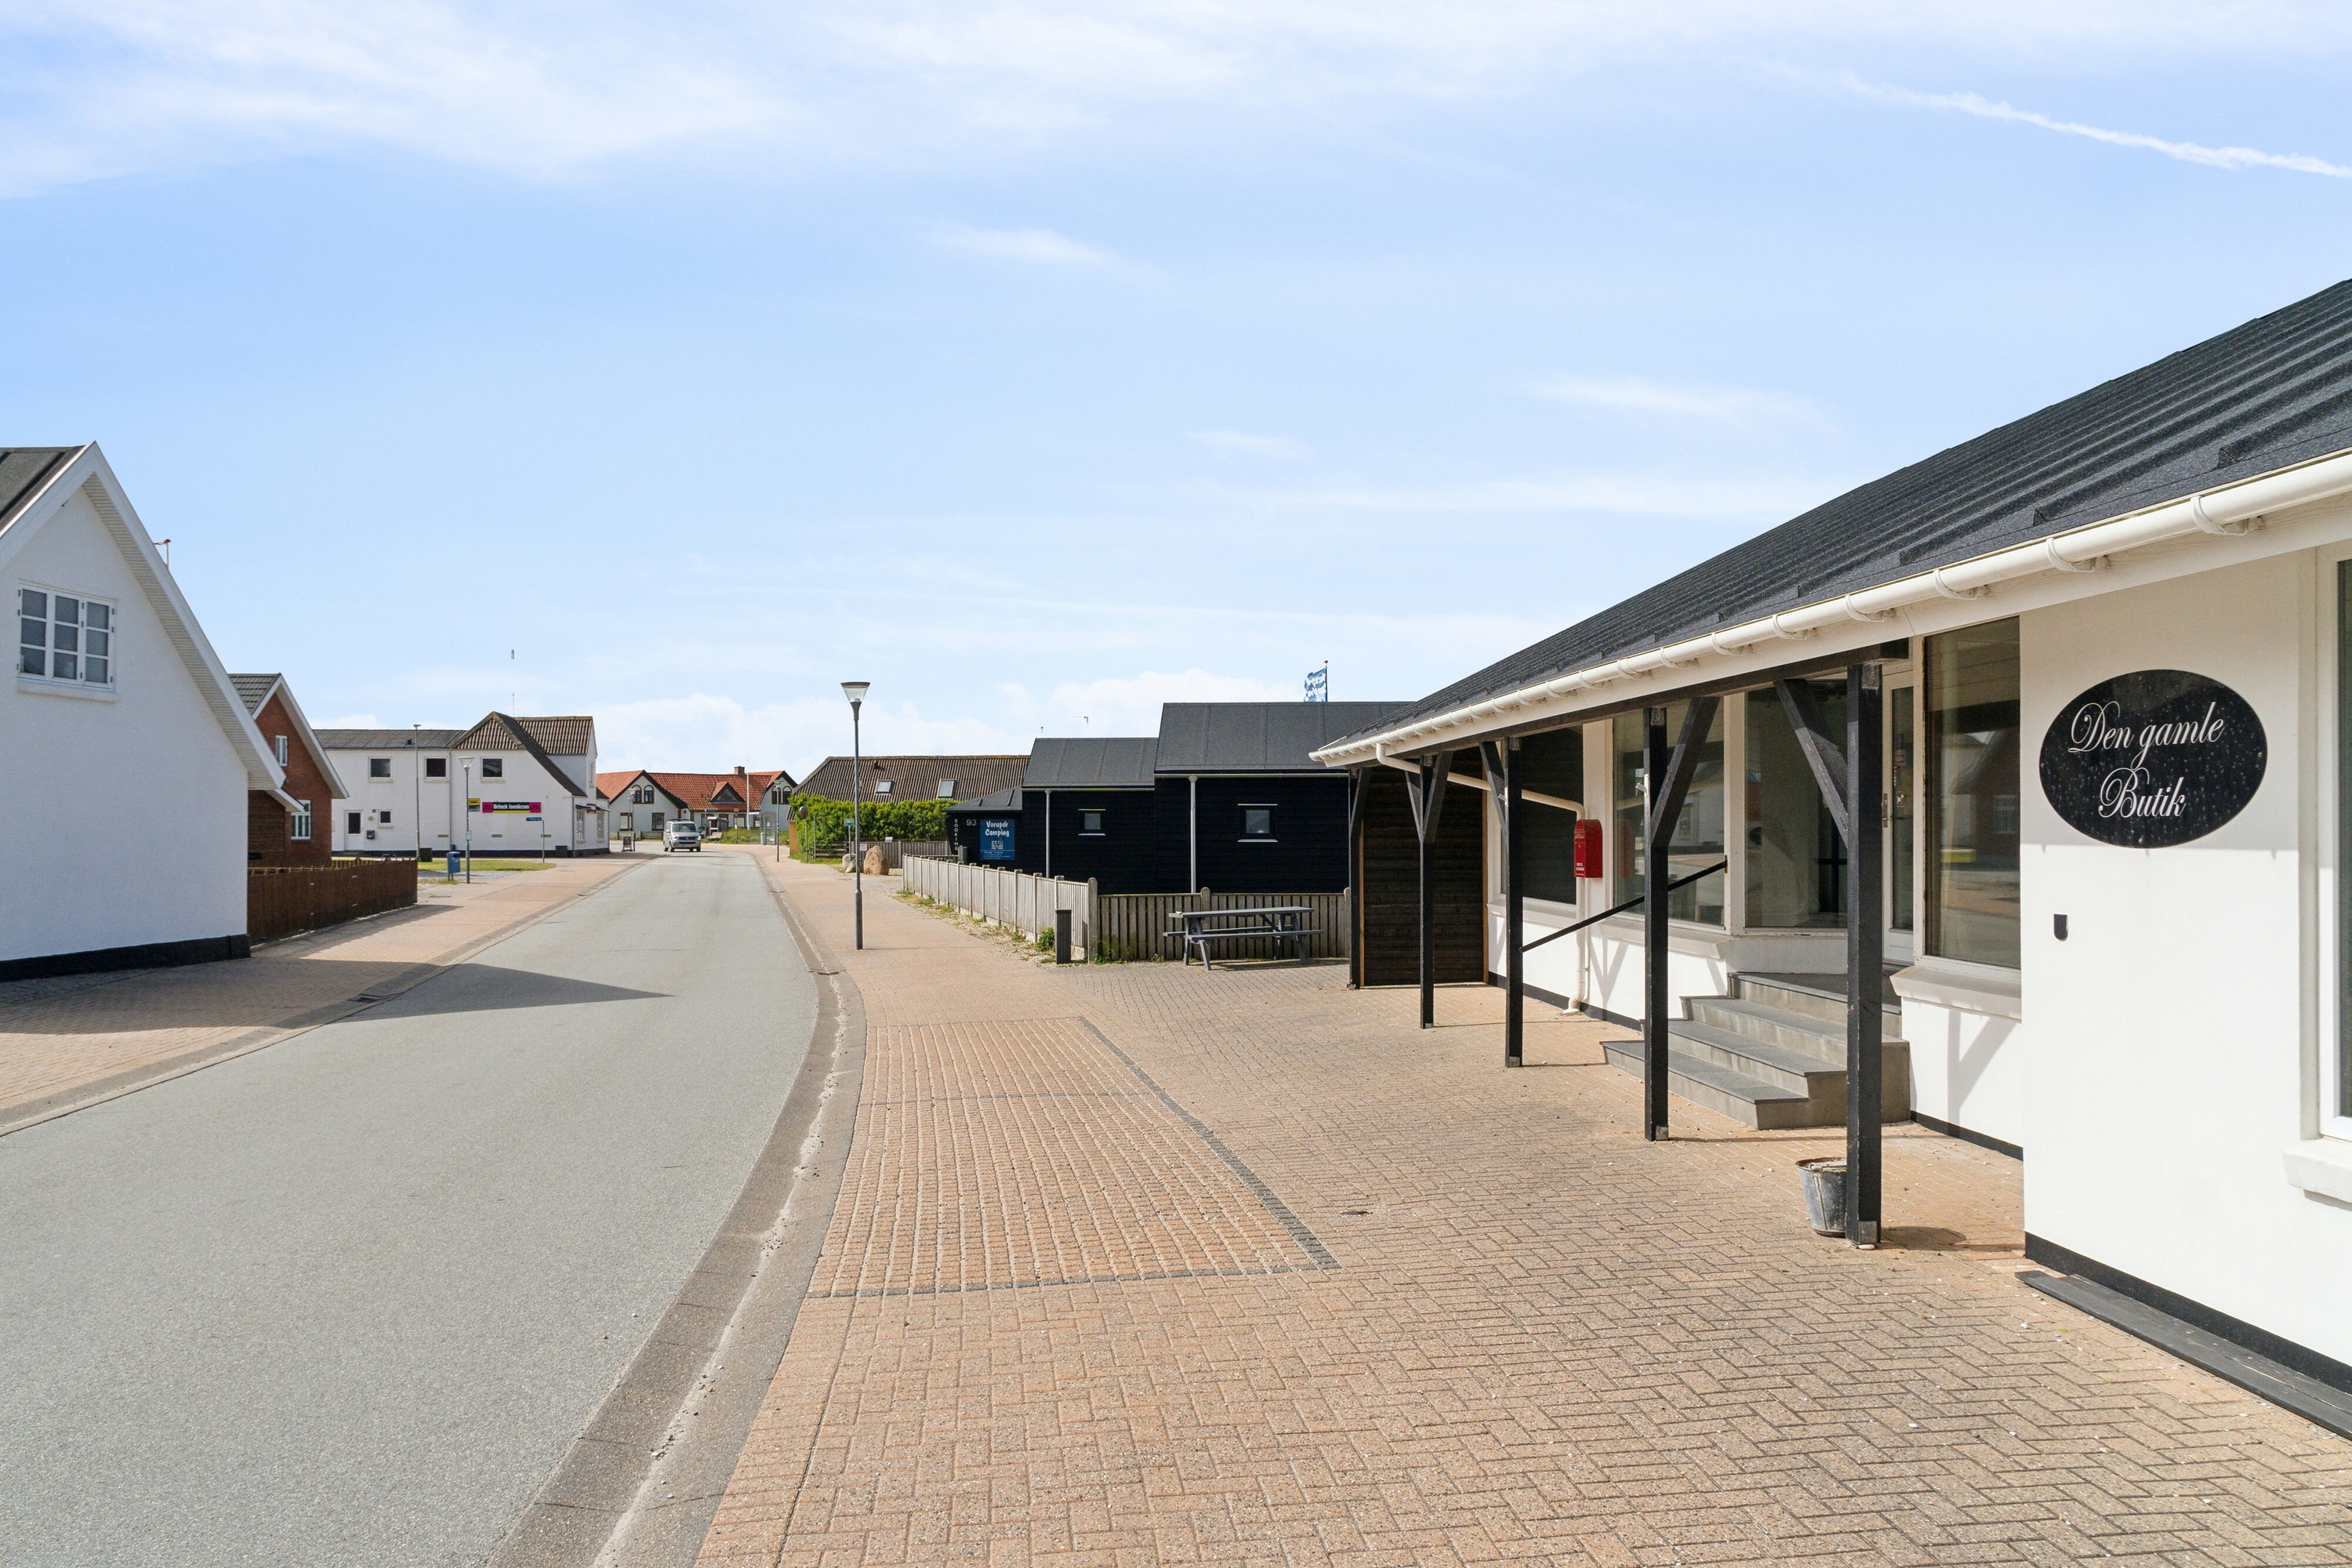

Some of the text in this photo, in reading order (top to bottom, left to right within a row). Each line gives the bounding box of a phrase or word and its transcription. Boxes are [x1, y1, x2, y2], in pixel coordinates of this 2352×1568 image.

[2068, 701, 2225, 771] Den gamle
[2098, 767, 2187, 818] Butik
